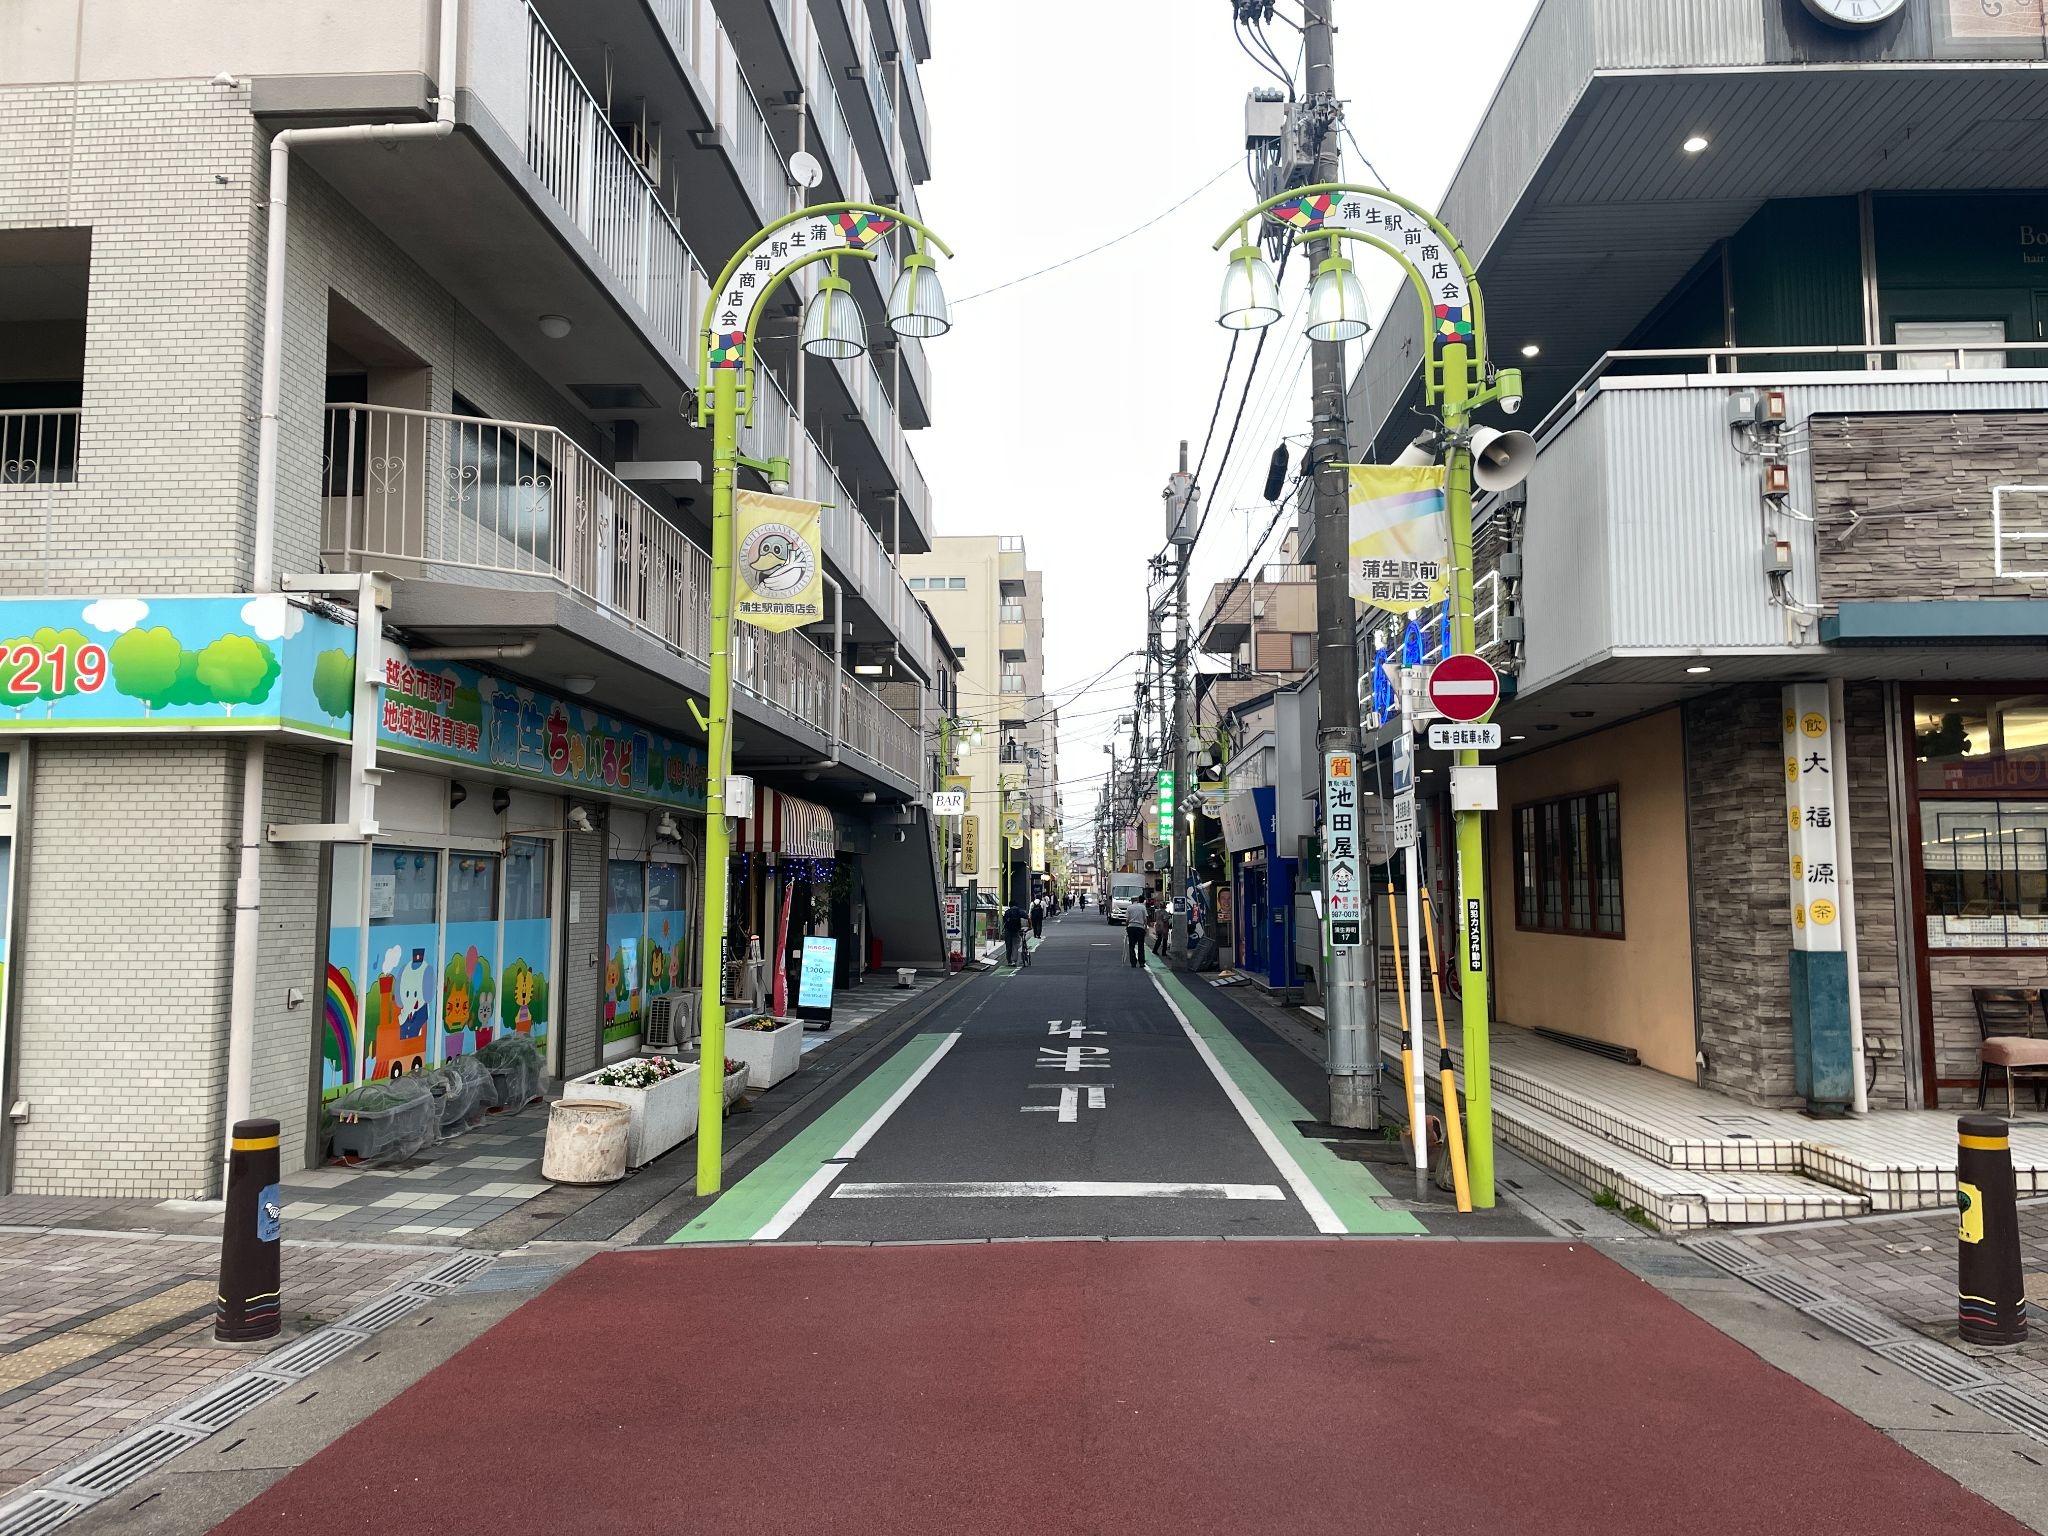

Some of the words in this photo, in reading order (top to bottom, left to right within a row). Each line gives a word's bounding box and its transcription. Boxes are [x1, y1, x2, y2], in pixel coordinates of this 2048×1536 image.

[721, 224, 827, 326] 蒲生駅前商店会
[1343, 202, 1459, 299] 蒲生駅前商店会
[2023, 252, 2045, 263] hair
[1362, 560, 1438, 580] 蒲生駅前
[1372, 582, 1430, 600] 商店会
[739, 602, 817, 614] 蒲生駅前商店会
[384, 658, 457, 709] 越谷市認可
[383, 698, 480, 753] 地域型保育事業
[1331, 758, 1351, 776] 質
[936, 795, 961, 806] BAR
[1330, 787, 1355, 860] 池田屋
[1803, 752, 1835, 884] 大福源
[1469, 901, 1481, 969] 防犯カメラ作動中
